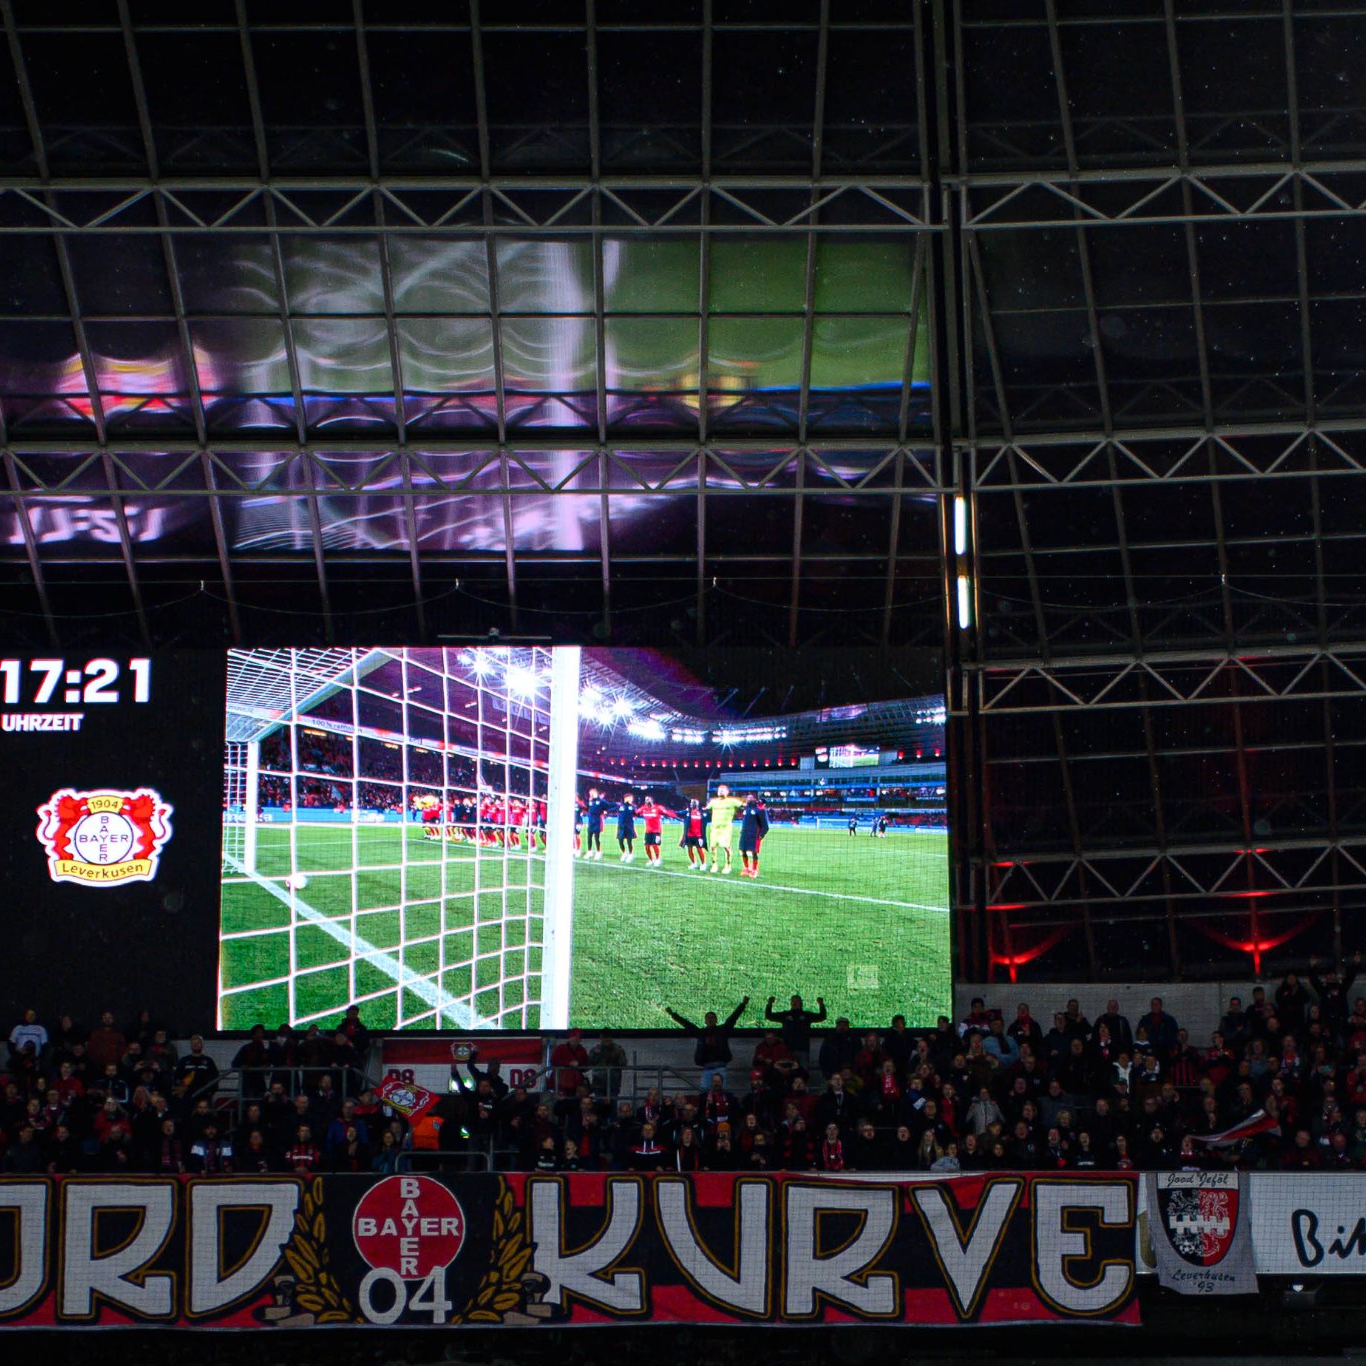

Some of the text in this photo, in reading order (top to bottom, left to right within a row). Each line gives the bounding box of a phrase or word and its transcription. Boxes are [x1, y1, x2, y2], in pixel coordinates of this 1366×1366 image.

[0, 657, 151, 704] 17:21
[1, 713, 84, 732] UHRZEIT
[91, 799, 119, 810] 1904
[79, 834, 129, 843] BAYER
[99, 815, 110, 862] BAYER
[62, 862, 143, 879] Leverkusen
[356, 1218, 461, 1237] BAYER
[399, 1178, 420, 1277] BAYER
[525, 1175, 1138, 1321] KURVE
[358, 1266, 453, 1325] 04
